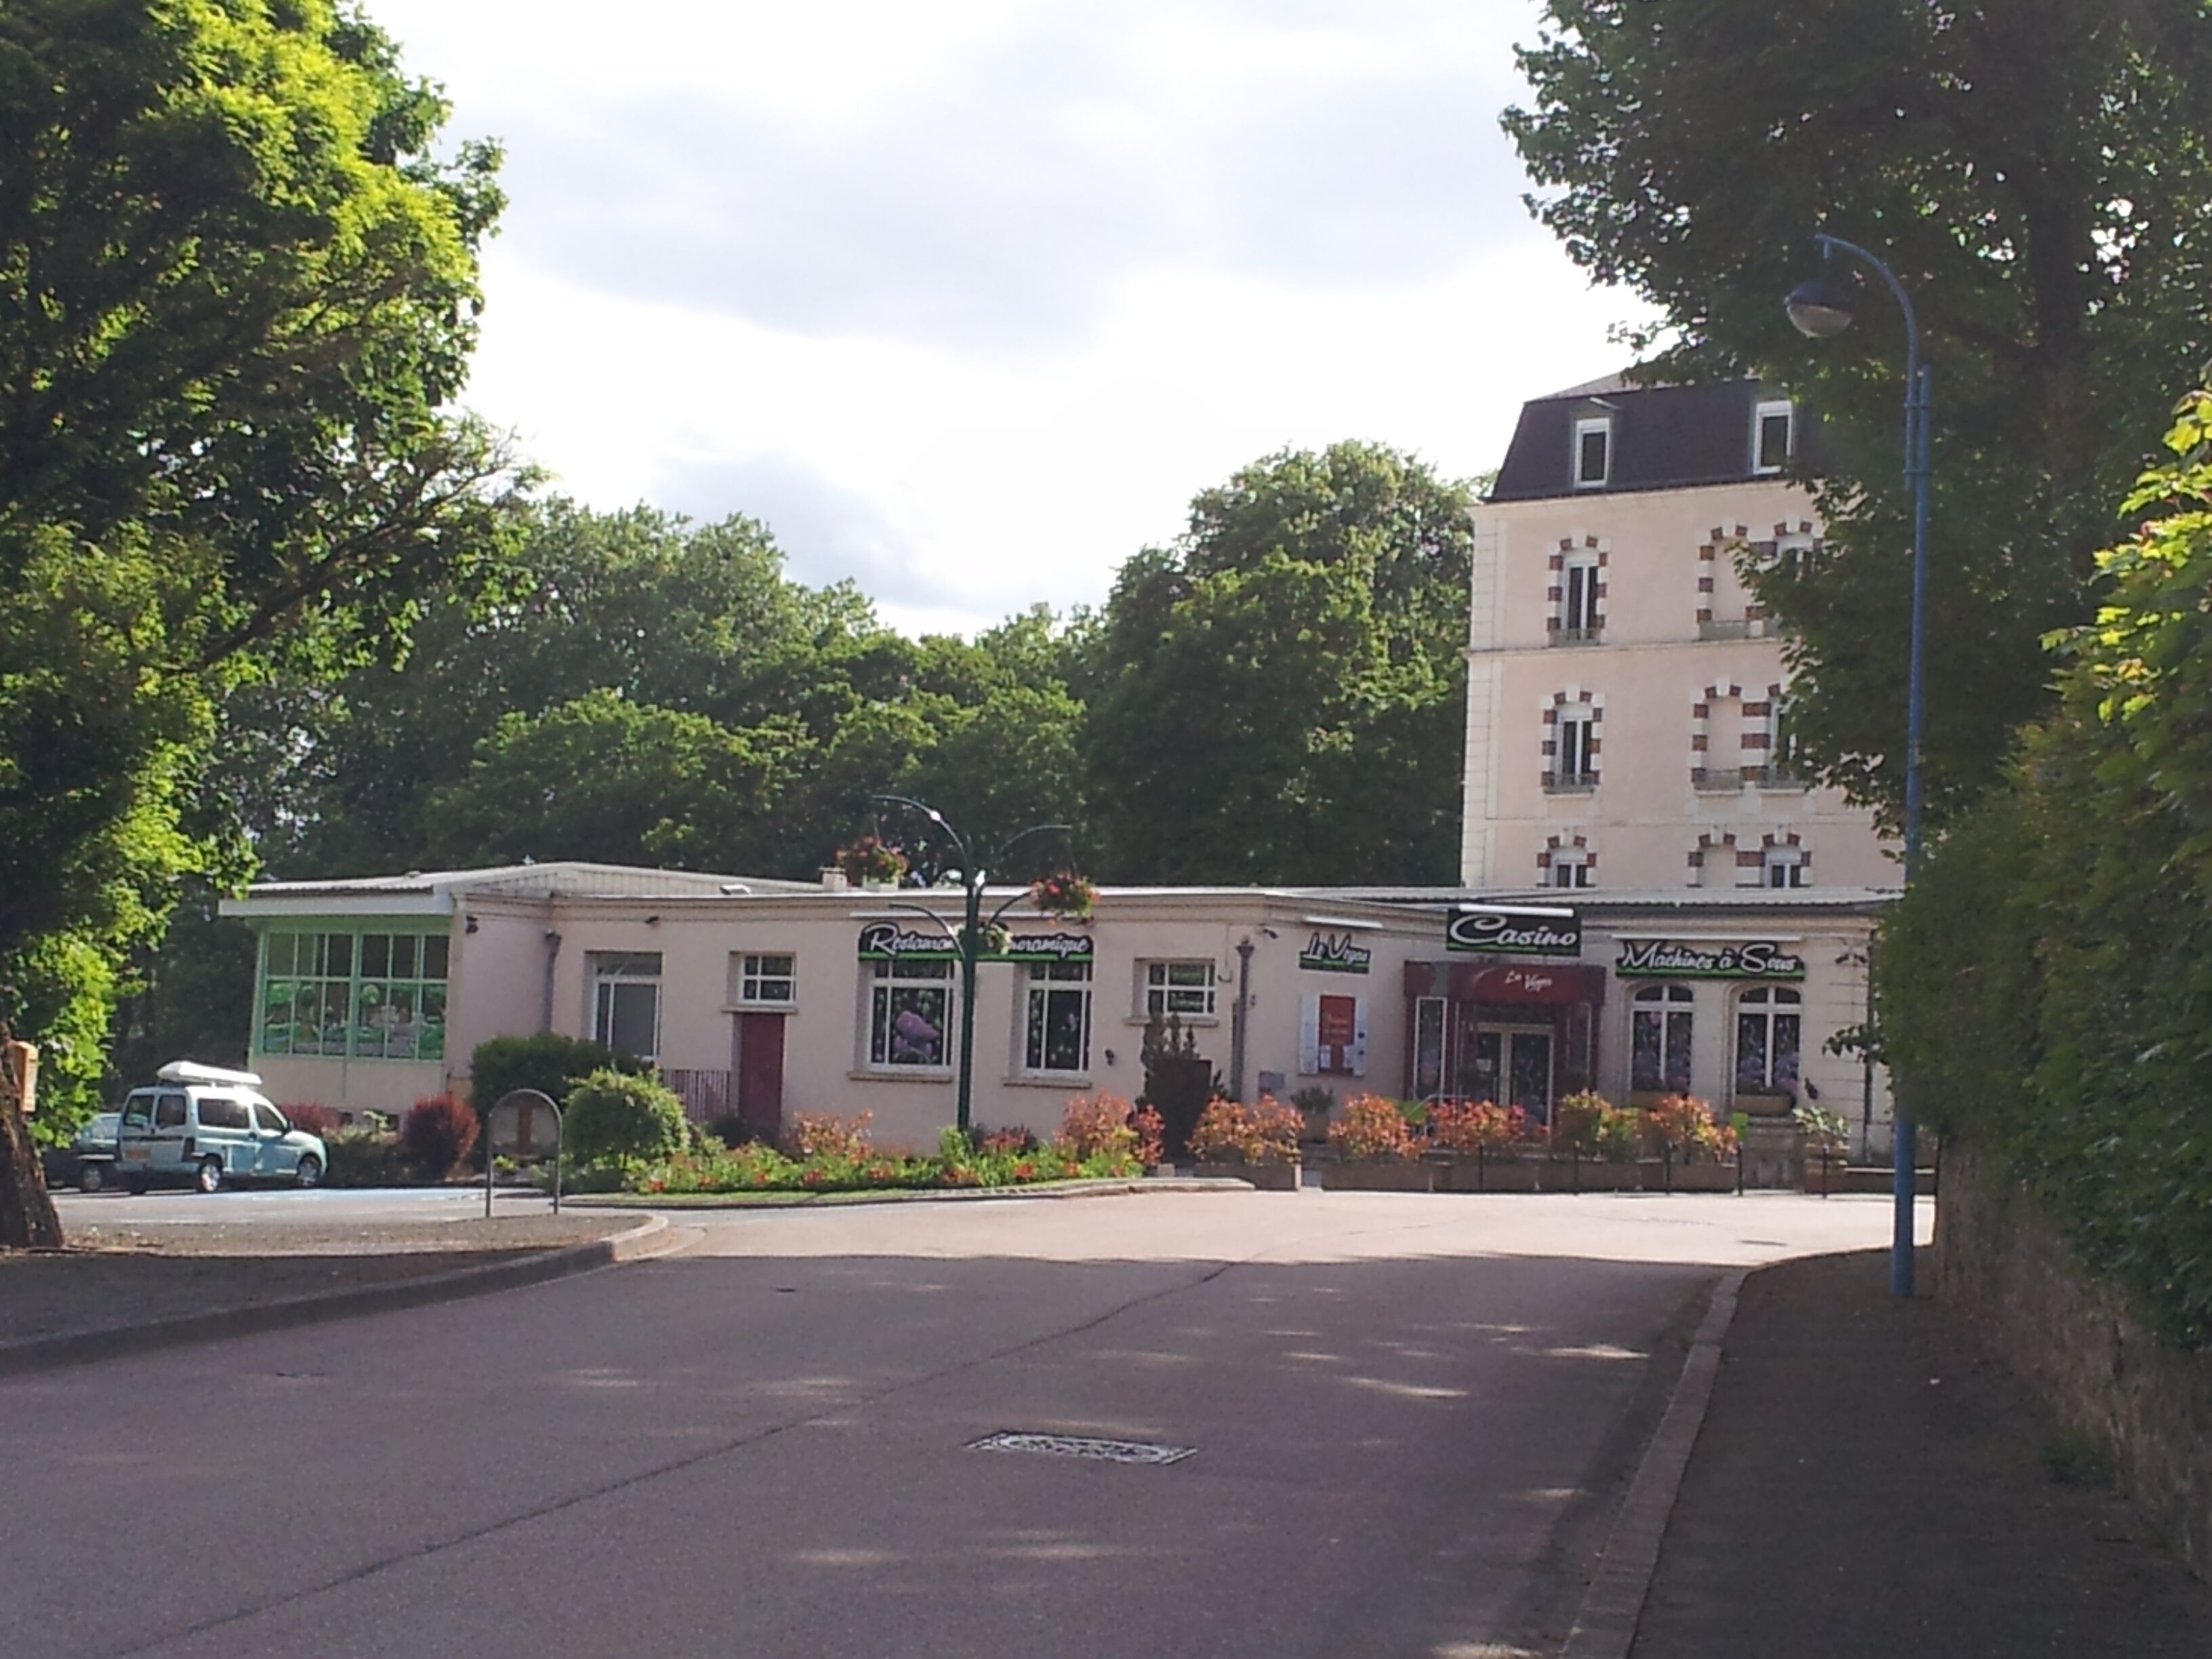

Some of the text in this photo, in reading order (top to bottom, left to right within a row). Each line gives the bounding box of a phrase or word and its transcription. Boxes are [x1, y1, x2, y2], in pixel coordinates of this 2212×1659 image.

[1450, 914, 1577, 946] Casino
[1621, 941, 1797, 973] Machines à Sous
